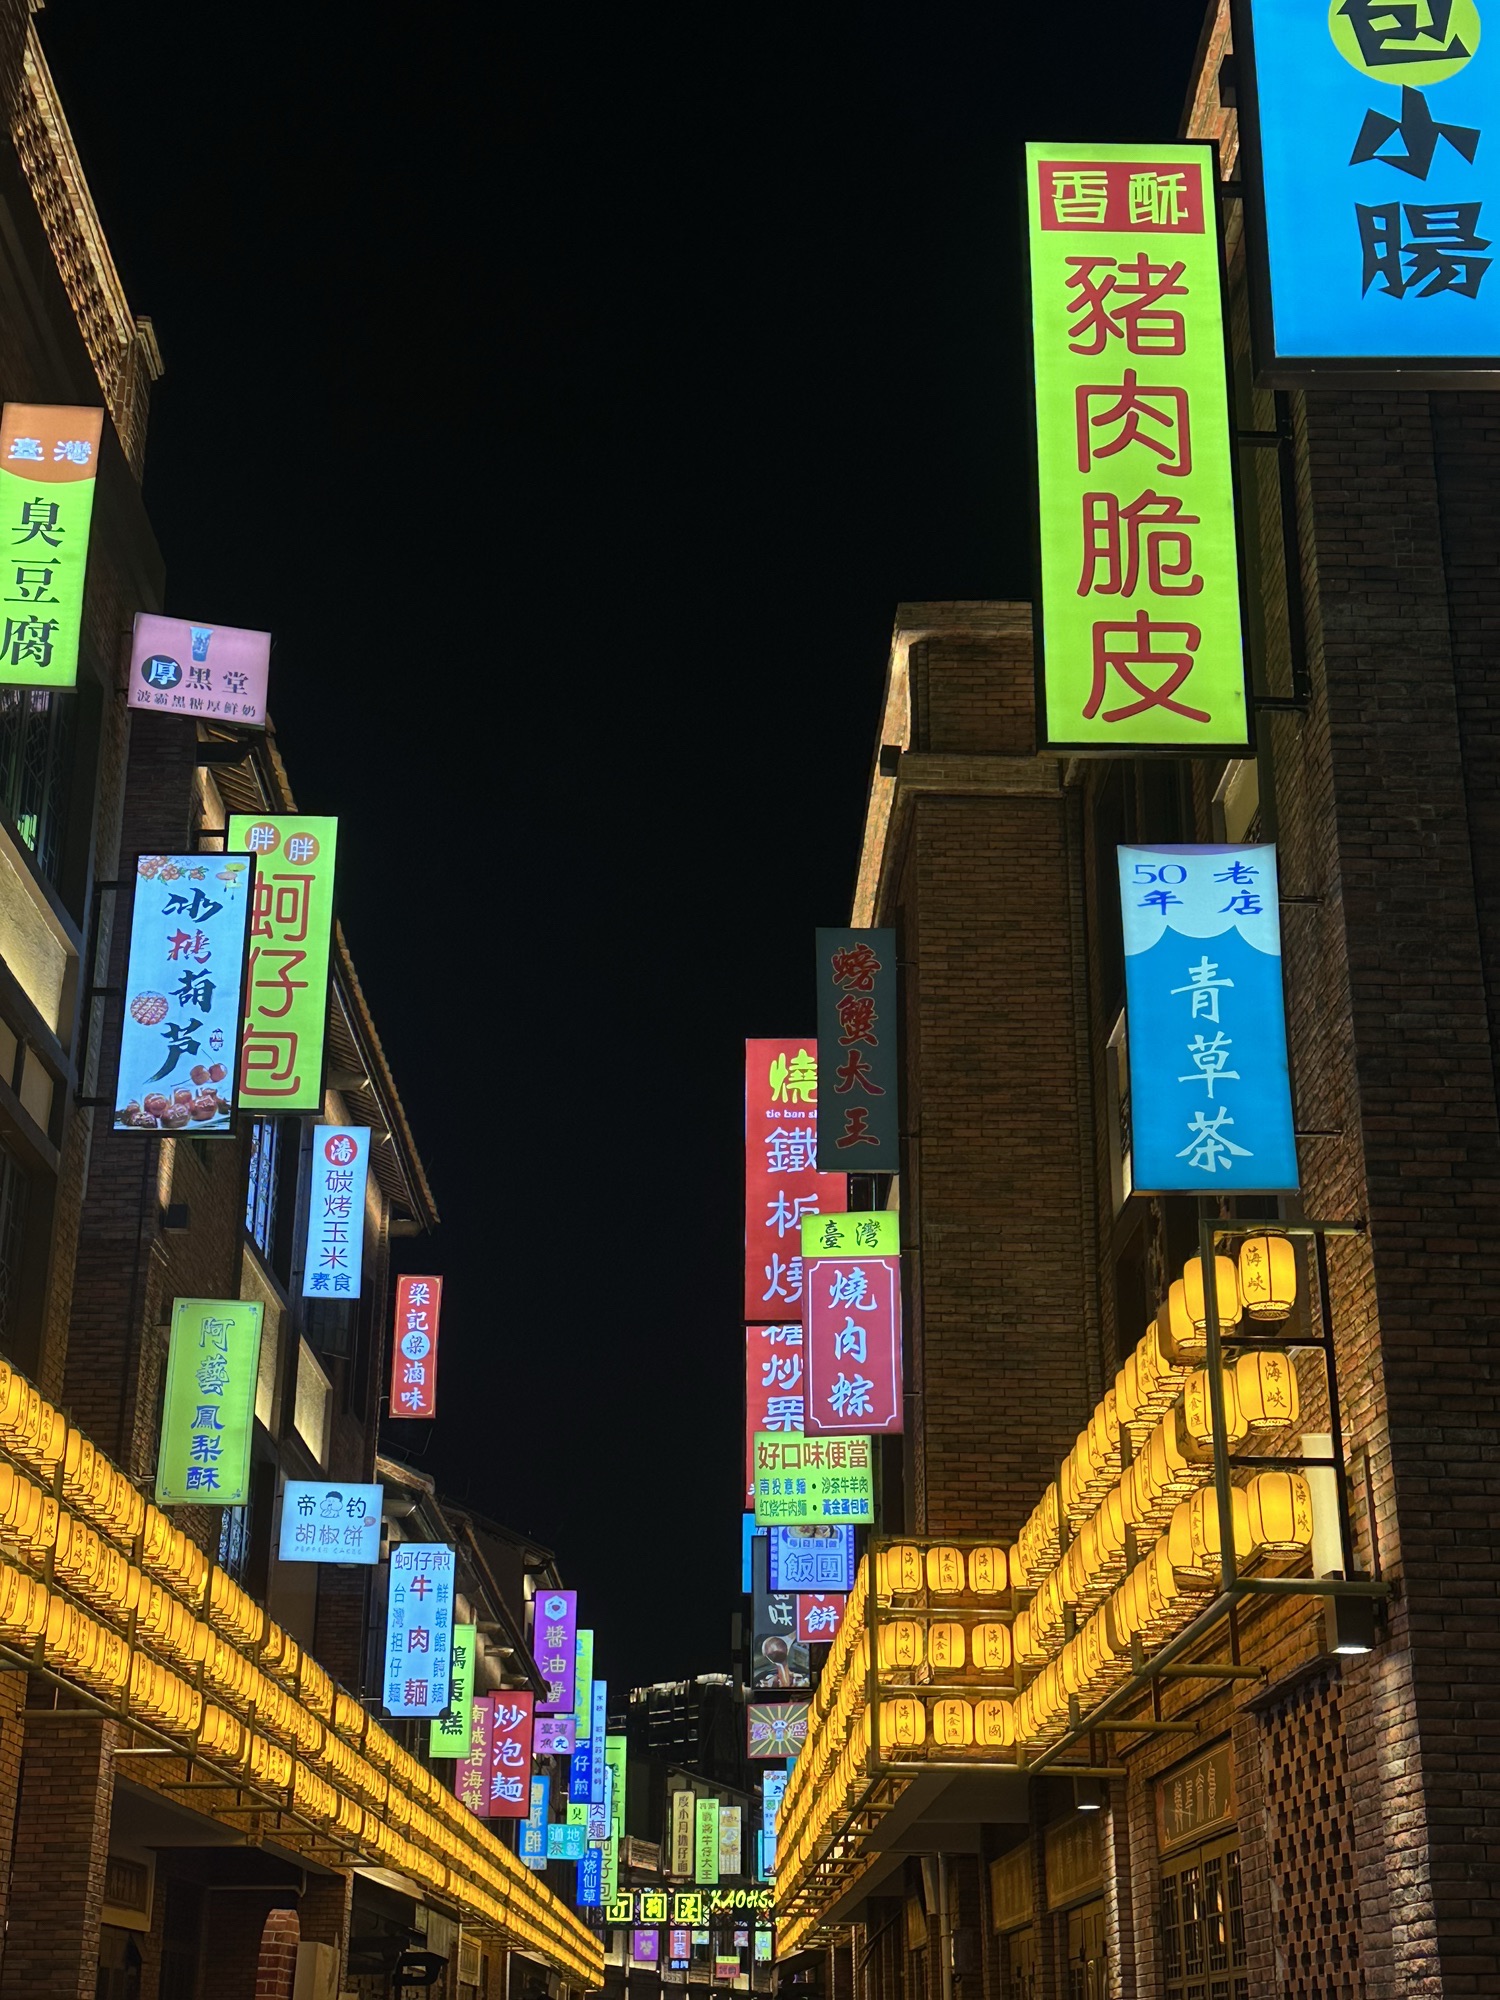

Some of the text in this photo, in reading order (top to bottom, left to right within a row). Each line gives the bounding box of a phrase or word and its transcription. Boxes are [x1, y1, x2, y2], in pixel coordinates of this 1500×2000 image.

[1052, 170, 1189, 225] 香酥
[8, 437, 92, 465] 臺灣
[1065, 252, 1211, 723] 豬肉脆皮
[0, 497, 66, 668] 臭豆腐
[147, 658, 249, 696] 厚黑堂
[249, 826, 314, 862] 胖胖
[831, 942, 886, 1149] 螃蟹大王
[1171, 955, 1254, 1173] 青草茶
[319, 1169, 354, 1270] 碳烤玉米
[820, 1219, 882, 1249] 臺灣
[310, 1272, 352, 1292] 素食
[827, 1267, 877, 1417] 燒肉粽
[186, 1316, 236, 1493] 阿藝鳳梨酥
[758, 1440, 868, 1470] 好口味便當
[395, 1551, 451, 1571] 蚵仔煎
[785, 1553, 842, 1582] 飯團
[403, 1574, 433, 1707] 牛肉麵
[491, 1704, 527, 1802] 炒泡麵
